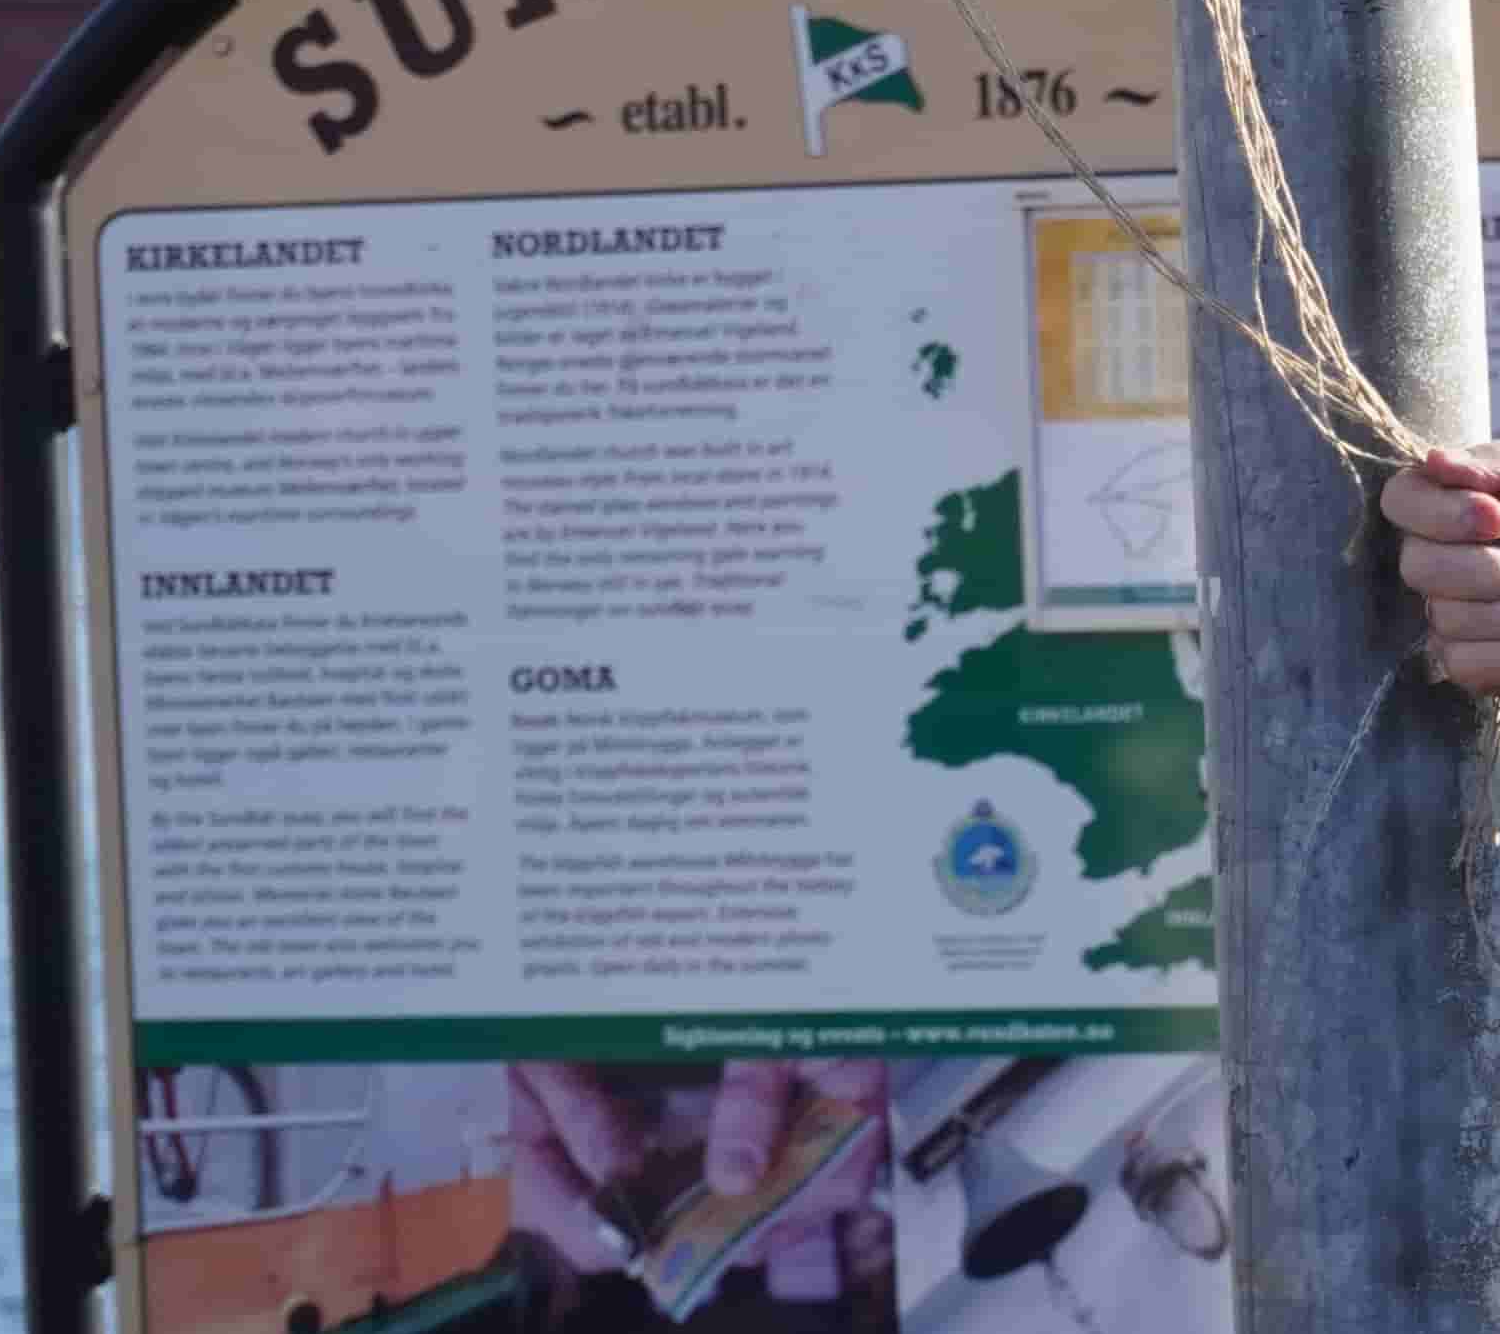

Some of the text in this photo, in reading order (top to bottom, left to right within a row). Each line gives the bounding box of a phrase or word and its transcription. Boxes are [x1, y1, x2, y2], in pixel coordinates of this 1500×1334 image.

[621, 69, 1077, 134] etabl. 1876
[125, 238, 365, 271] KIRKELANDET
[491, 223, 726, 260] NORDLANDET
[140, 569, 335, 600] INNLANDET
[510, 664, 617, 695] GOMA
